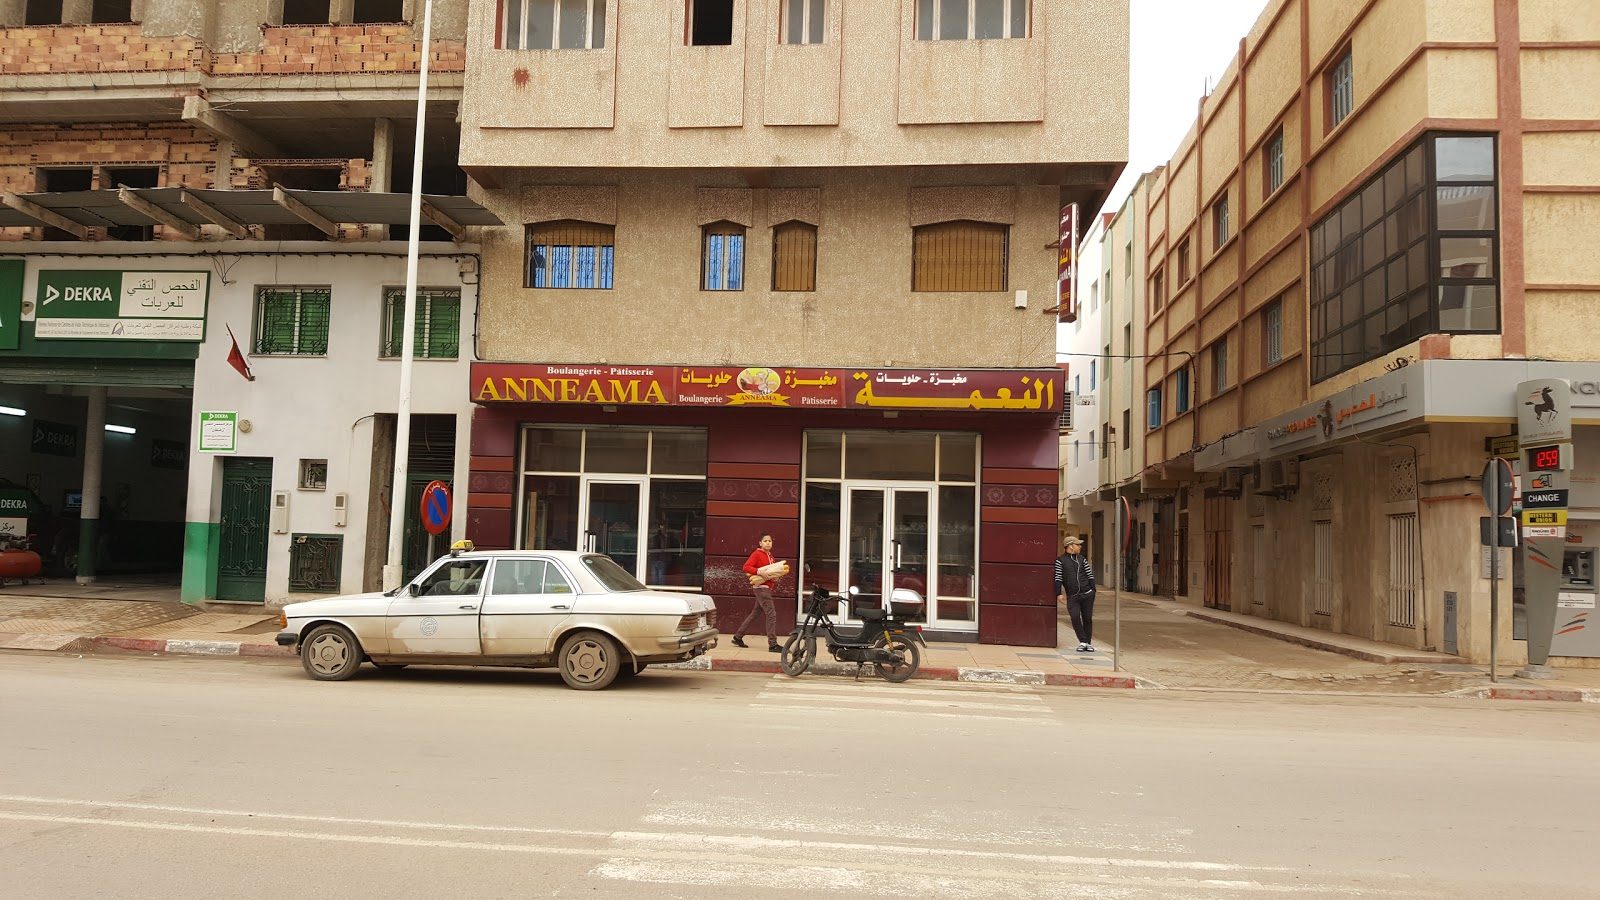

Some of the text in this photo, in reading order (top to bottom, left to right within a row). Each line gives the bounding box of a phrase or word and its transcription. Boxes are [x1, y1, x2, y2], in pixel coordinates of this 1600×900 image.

[64, 287, 113, 301] DEKRA
[127, 279, 200, 295] الفحص التقني
[141, 296, 184, 311] للعربات
[547, 366, 602, 376] Boulangerie
[681, 368, 733, 388] حلويات
[784, 370, 837, 389] مخبزة
[876, 372, 921, 386] حلويات
[929, 373, 967, 386] مخبزة
[475, 376, 670, 404] ANNEAMA
[853, 371, 1054, 410] النعمة
[679, 394, 723, 404] Boulangerie
[0, 499, 27, 509] DEKRA
[1528, 493, 1560, 502] CHANGE
